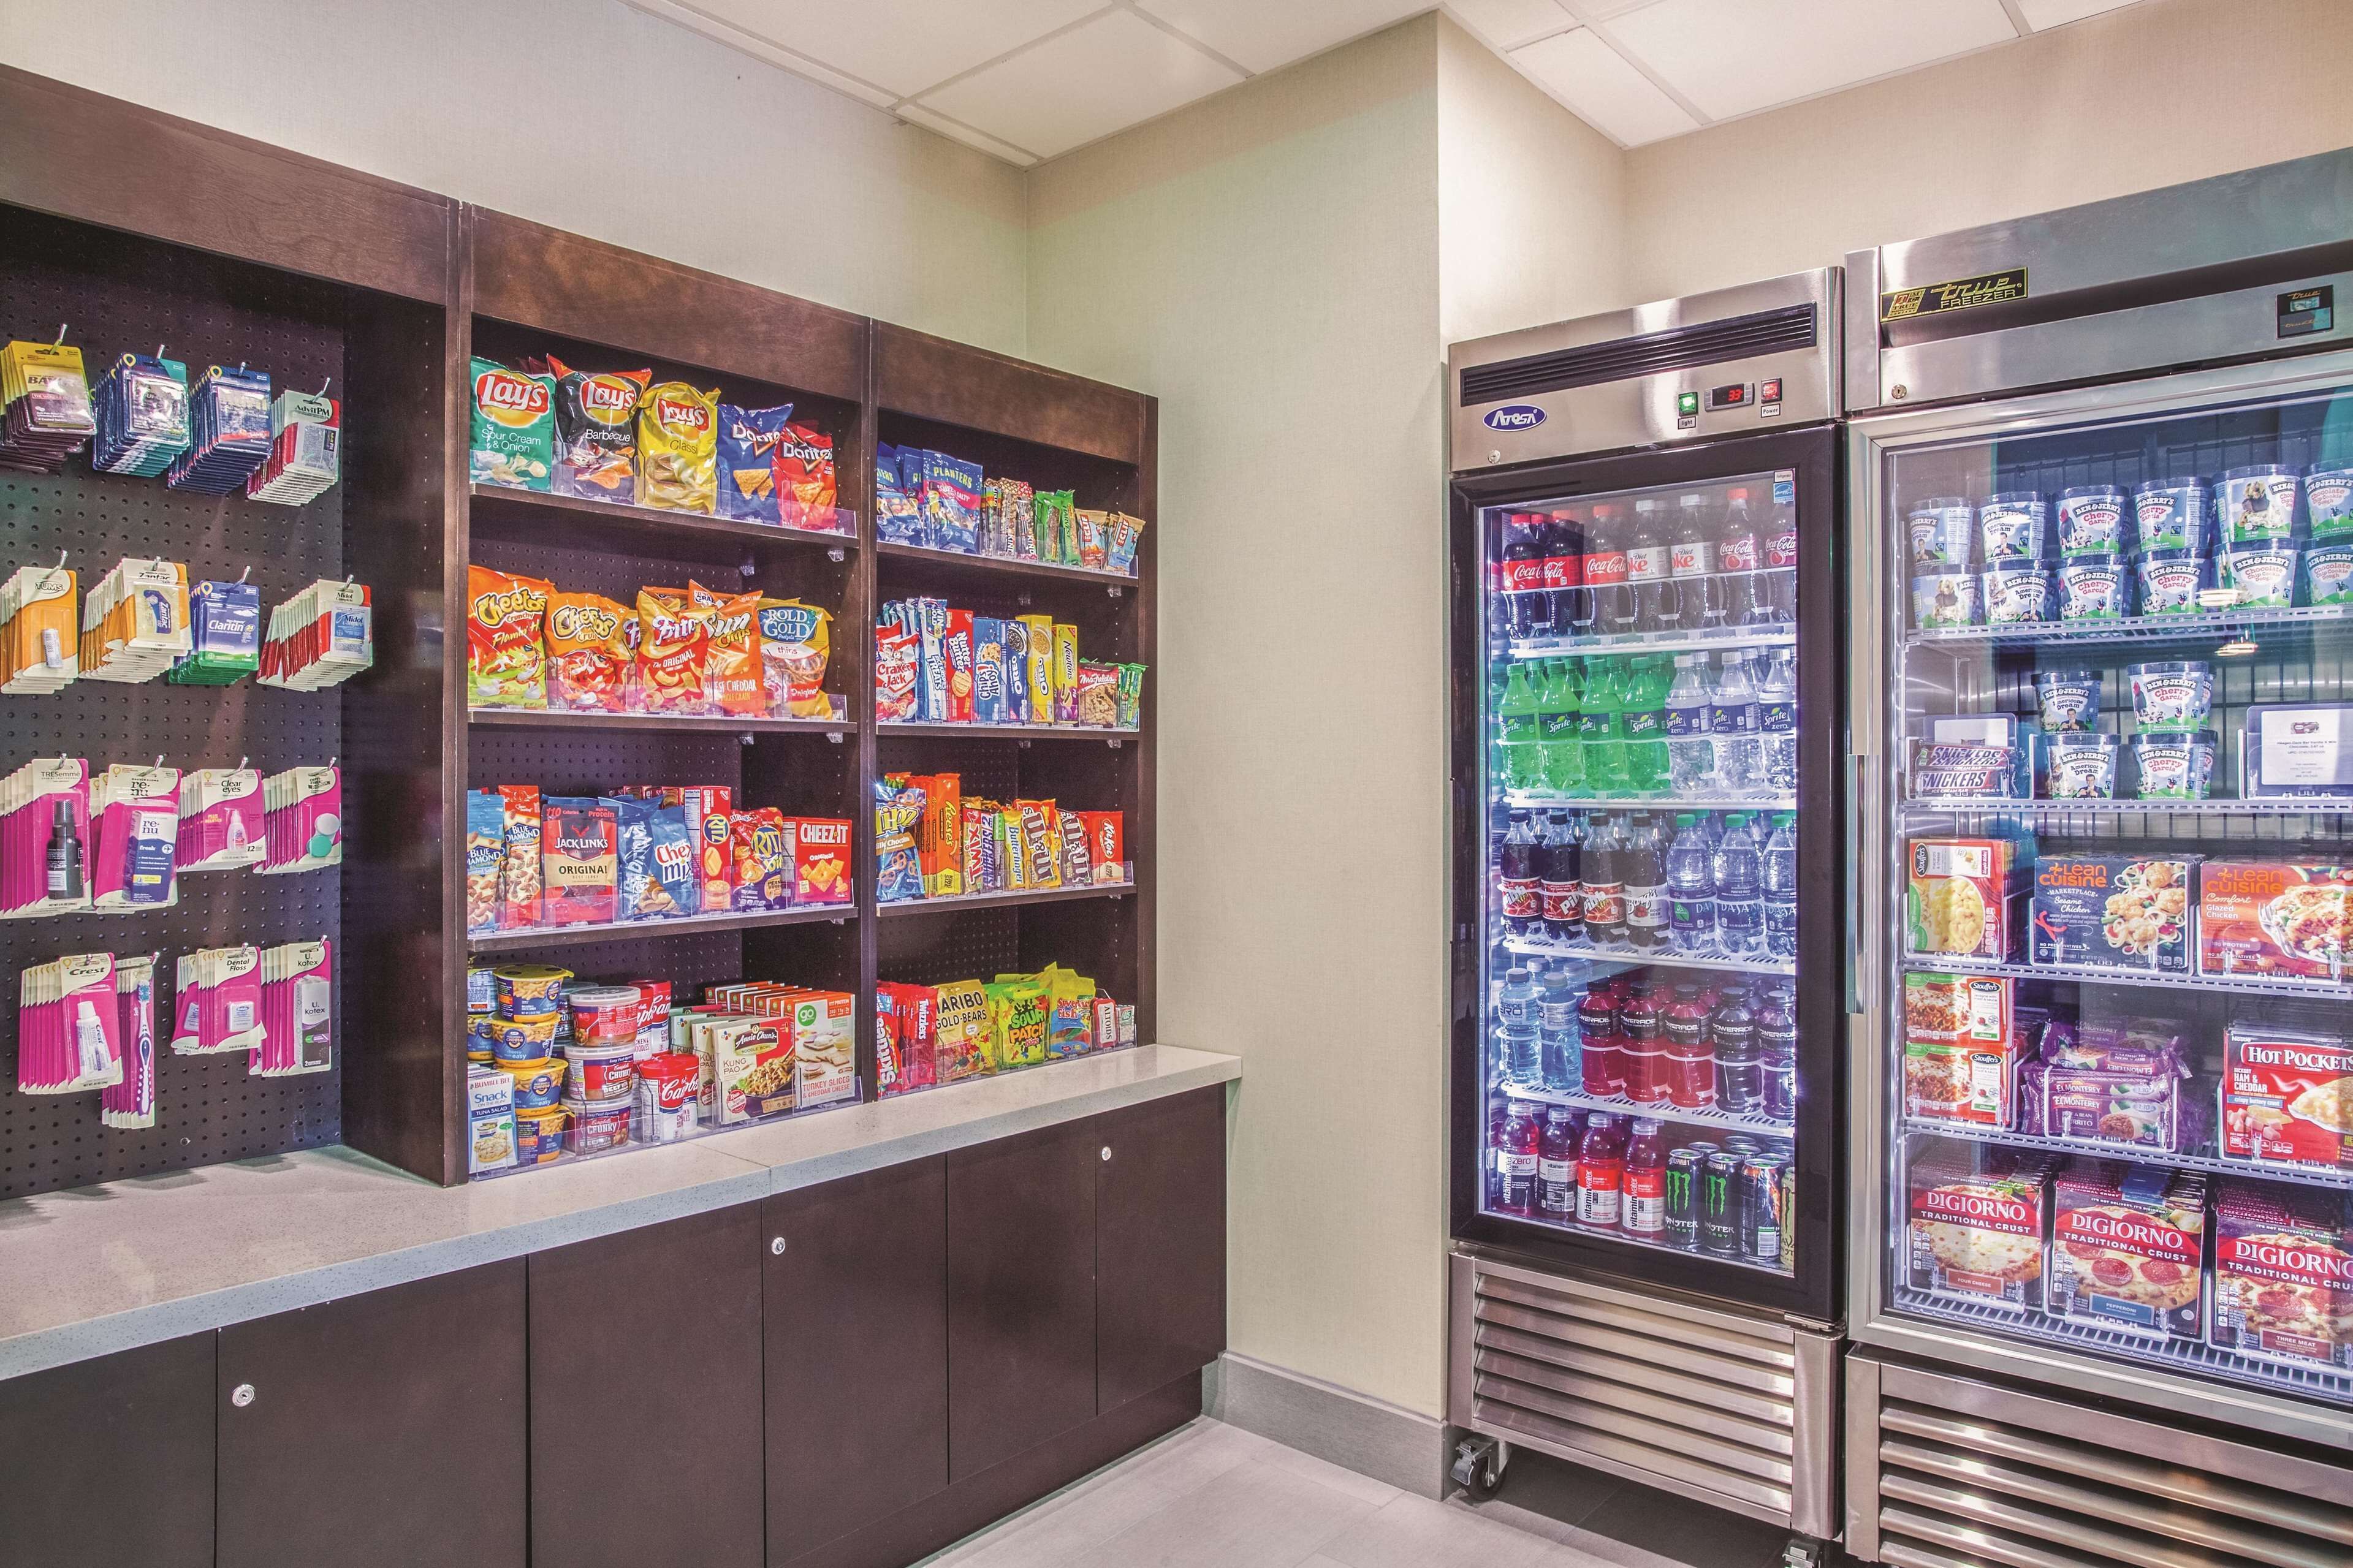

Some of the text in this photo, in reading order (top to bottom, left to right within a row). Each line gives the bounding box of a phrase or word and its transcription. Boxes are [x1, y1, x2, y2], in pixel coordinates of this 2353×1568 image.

[1941, 289, 2015, 309] FREEZER
[482, 375, 546, 410] Lay's
[586, 381, 636, 410] Lay's
[663, 398, 705, 426] Lay's
[481, 429, 541, 446] Sour Cream
[585, 429, 631, 442] Barbecue
[501, 442, 530, 453] Onion
[933, 466, 973, 488] PLANTERS
[2083, 510, 2116, 523] Cherry
[1720, 539, 1755, 556] Coca-Cola
[138, 572, 170, 581] Zantac
[2157, 574, 2194, 586] Cherry
[36, 582, 63, 591] TUMS
[2077, 580, 2112, 591] Cherry
[344, 615, 364, 623] Midol
[507, 613, 534, 623] Crunchy
[767, 608, 808, 623] ROLD
[208, 619, 243, 631] Claritin
[553, 607, 616, 639] Cheetos
[703, 612, 751, 640] Sun
[764, 621, 810, 639] GOLD
[777, 645, 798, 654] thins
[956, 631, 971, 668] Nutter
[663, 648, 696, 667] ORIGINAL
[1063, 640, 1073, 680] Newtons
[882, 673, 907, 689] Jack
[1011, 656, 1022, 695] OREO
[1038, 657, 1049, 695] OREO
[727, 679, 758, 692] CHEDDAR
[791, 686, 819, 696] Original
[979, 670, 992, 700] Chips
[2154, 687, 2190, 697] Cherry
[1765, 710, 1787, 725] Sprite
[1548, 719, 1571, 733] Sprite
[1631, 718, 1655, 734] Sprite
[1921, 771, 1988, 789] SNICKERS
[512, 824, 530, 834] BLUE
[710, 815, 727, 843] RITZ
[945, 800, 957, 847] Reese's
[505, 828, 540, 843] DIAMOND
[555, 838, 609, 849] JACK LINK'S
[469, 847, 490, 858] BLUE
[809, 851, 834, 861] ORIGINAL
[966, 824, 984, 884] TWIX
[1008, 827, 1023, 883] Butterfinger
[2055, 896, 2082, 905] Sesame
[2206, 893, 2251, 904] Comfort
[2061, 904, 2091, 914] Chicken
[2207, 904, 2235, 913] Glazed
[2207, 911, 2239, 920] Chicken
[69, 967, 105, 976] Crest
[1973, 982, 1999, 992] Stouffer's
[800, 1009, 815, 1022] go
[1011, 1011, 1044, 1029] SOUR
[96, 1024, 104, 1043] Crest
[736, 1030, 777, 1047] Annie Chun's
[1973, 1055, 2000, 1064] Stouffer's
[2248, 1047, 2283, 1064] HOT
[723, 1058, 747, 1068] KUNG
[723, 1065, 740, 1075] PAO
[474, 1080, 498, 1089] BUMBLE
[802, 1075, 850, 1091] TURKEY SLICES
[2234, 1073, 2259, 1083] HAM &
[807, 1083, 850, 1097] CHEDDAR CHEESE
[2234, 1081, 2268, 1093] CHEDDAR
[474, 1089, 507, 1104] Snack
[2063, 1096, 2100, 1108] MONTEREY
[587, 1123, 617, 1134] CHUNKY
[1921, 1210, 2031, 1234] TRADITIONAL CRUST
[2064, 1232, 2188, 1263] TRADITIONAL CRUST
[2227, 1261, 2318, 1285] TRADITIONAL
[1973, 1279, 1991, 1288] CHEESE
[2105, 1302, 2137, 1313] PEPPERONI
[2276, 1335, 2316, 1347] THREE MEAT
